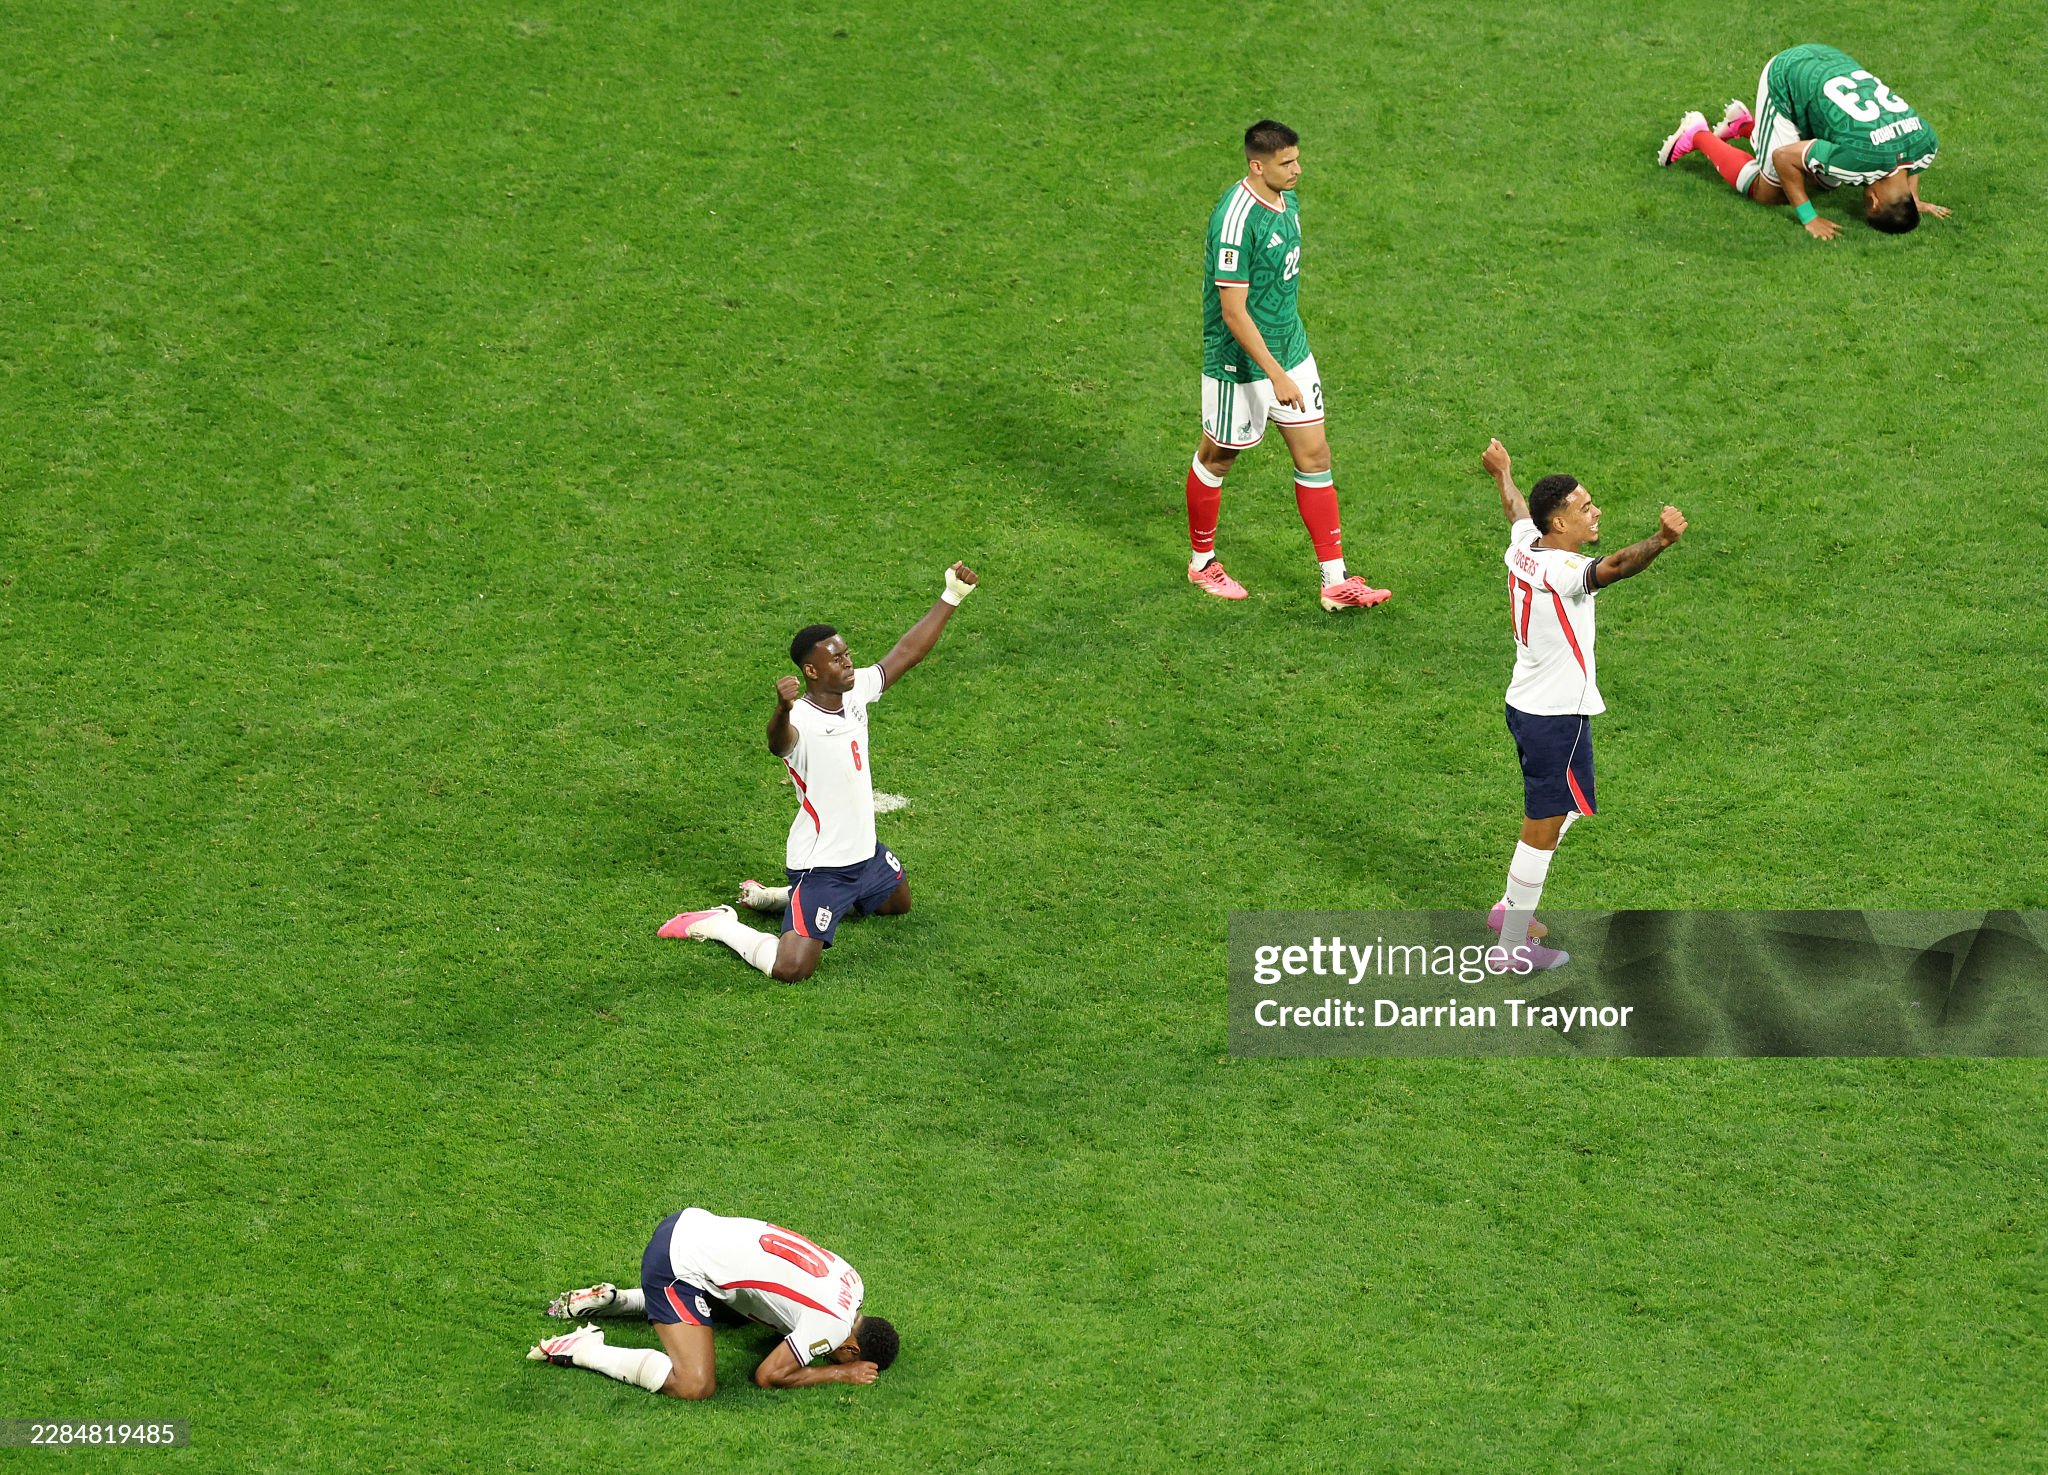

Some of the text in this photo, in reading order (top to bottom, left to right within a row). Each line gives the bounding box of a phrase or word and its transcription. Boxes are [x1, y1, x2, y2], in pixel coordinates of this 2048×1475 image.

[1822, 70, 1909, 122] 23
[1283, 246, 1301, 281] 22
[1312, 382, 1325, 410] 2
[1511, 546, 1540, 577] ROGERS
[1508, 569, 1533, 647] 17
[850, 740, 862, 772] 6
[885, 850, 902, 873] 6
